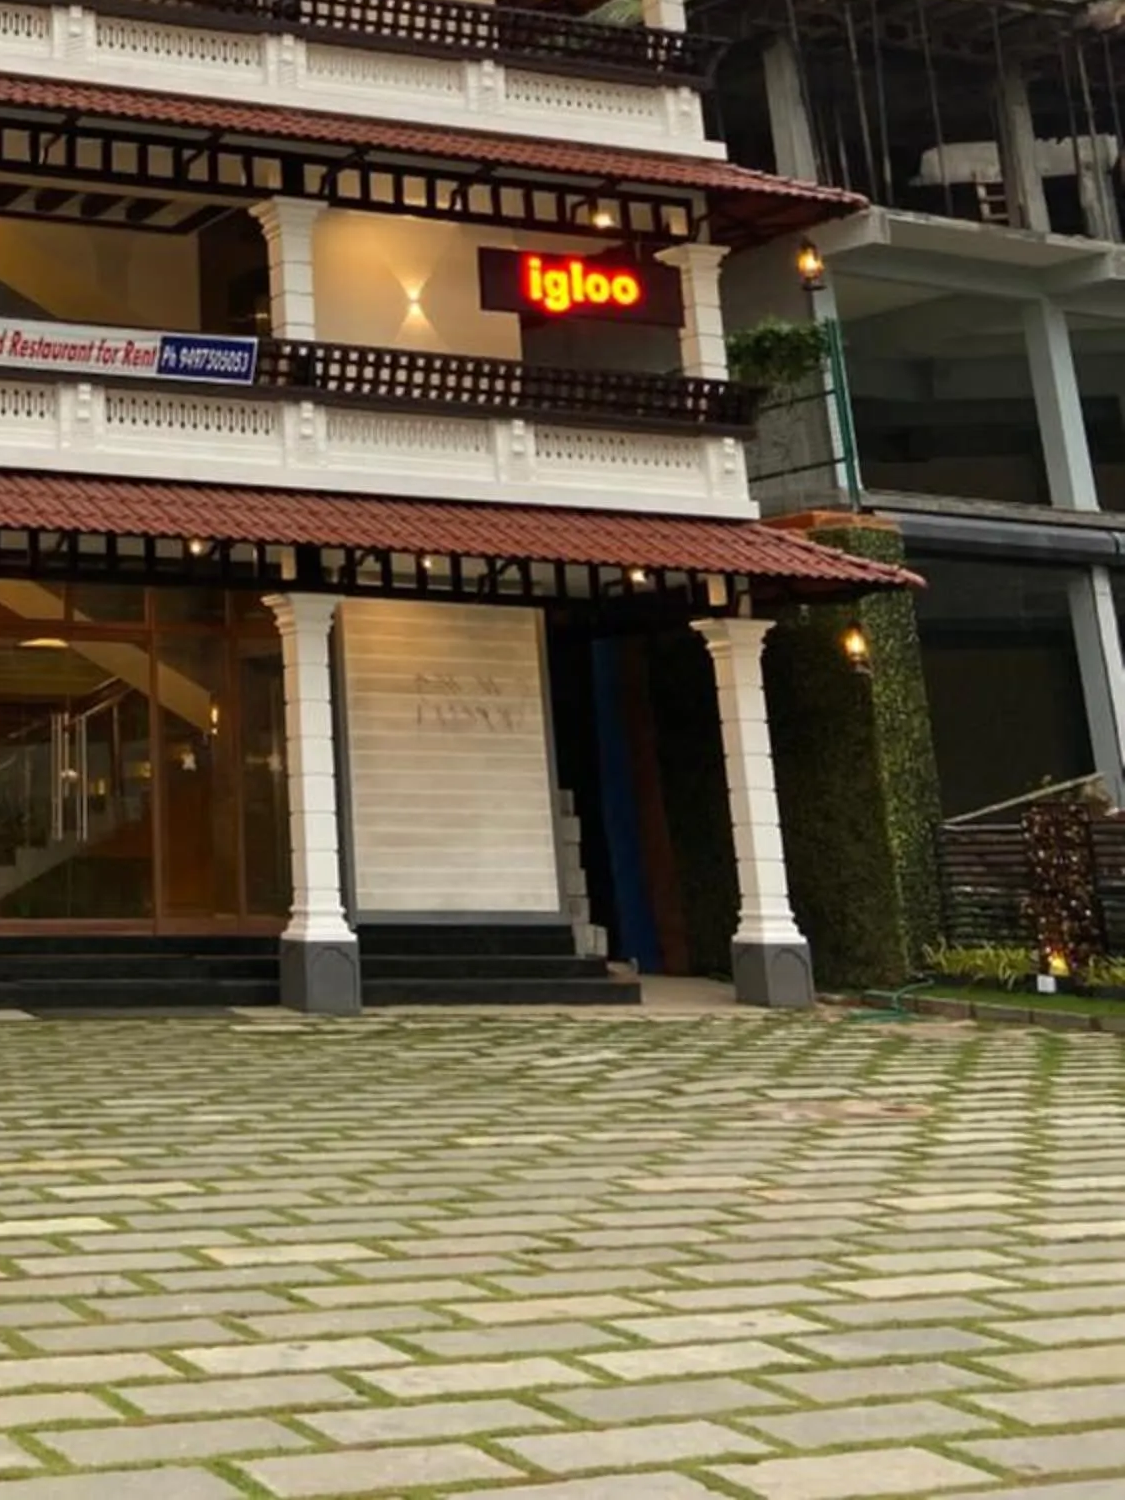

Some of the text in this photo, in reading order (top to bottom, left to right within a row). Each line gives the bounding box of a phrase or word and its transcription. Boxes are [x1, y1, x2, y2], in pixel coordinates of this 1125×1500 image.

[528, 256, 640, 312] igloo
[9, 330, 95, 363] Restaurant
[96, 338, 119, 366] for
[120, 340, 157, 367] Rent
